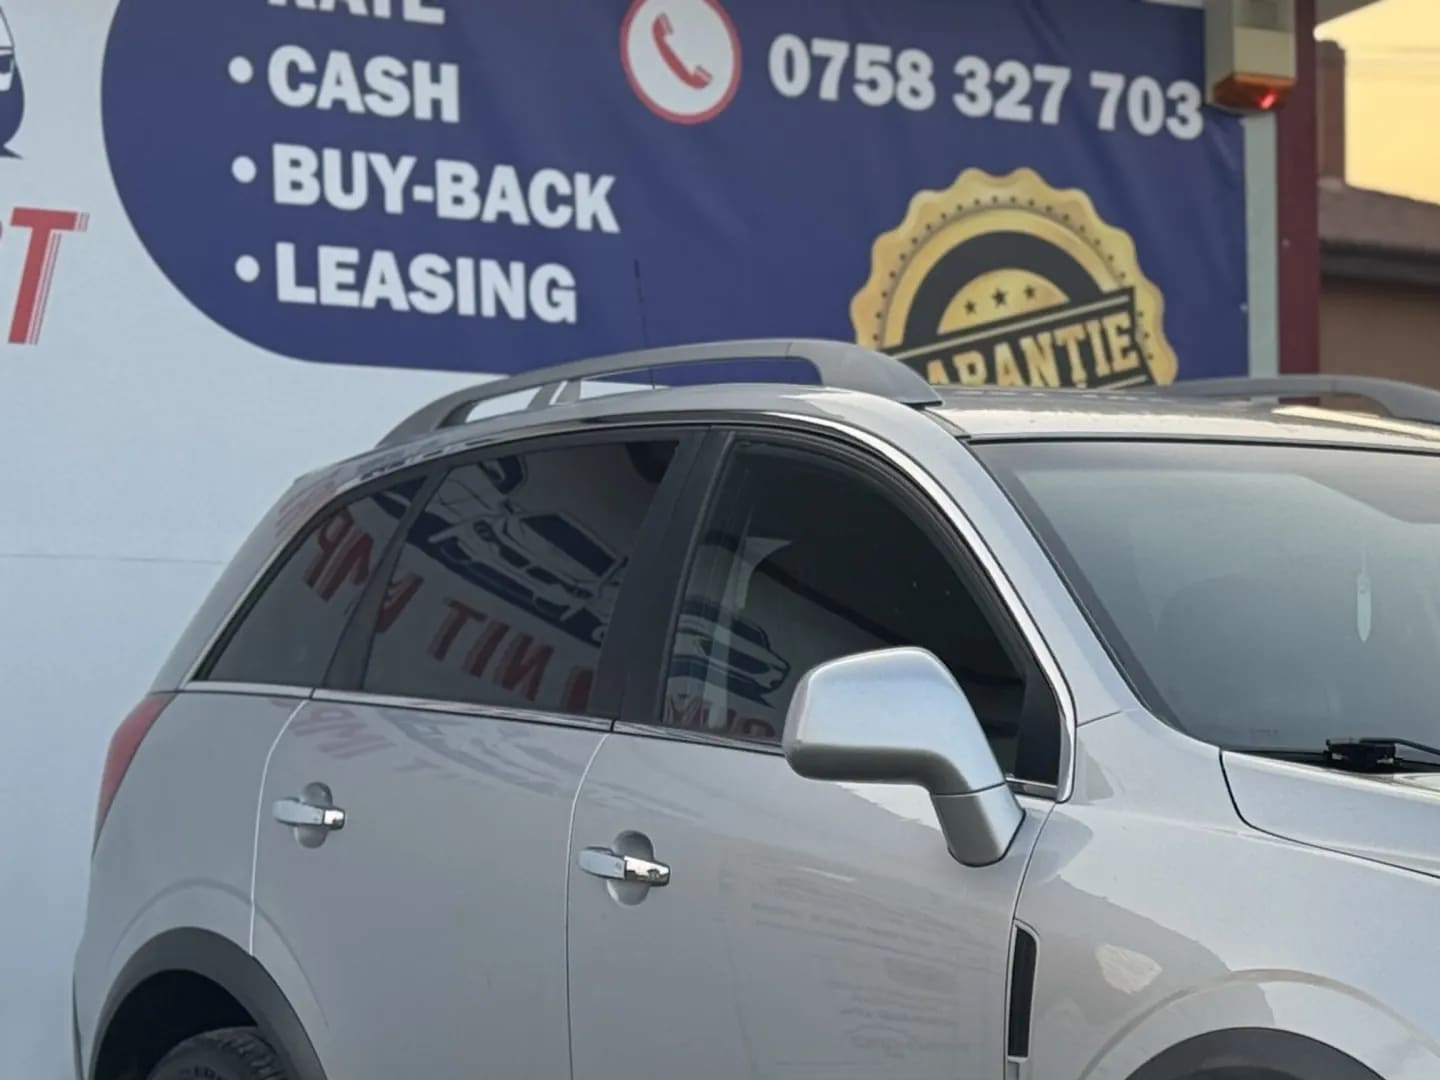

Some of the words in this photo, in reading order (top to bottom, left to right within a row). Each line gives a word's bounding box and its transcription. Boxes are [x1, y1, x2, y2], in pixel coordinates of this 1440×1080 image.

[267, 45, 459, 122] CASH
[768, 34, 935, 111] 0758
[953, 56, 1071, 124] 327
[1090, 71, 1204, 139] 703
[272, 143, 620, 233] BUY-BACK
[275, 242, 577, 323] LEASING
